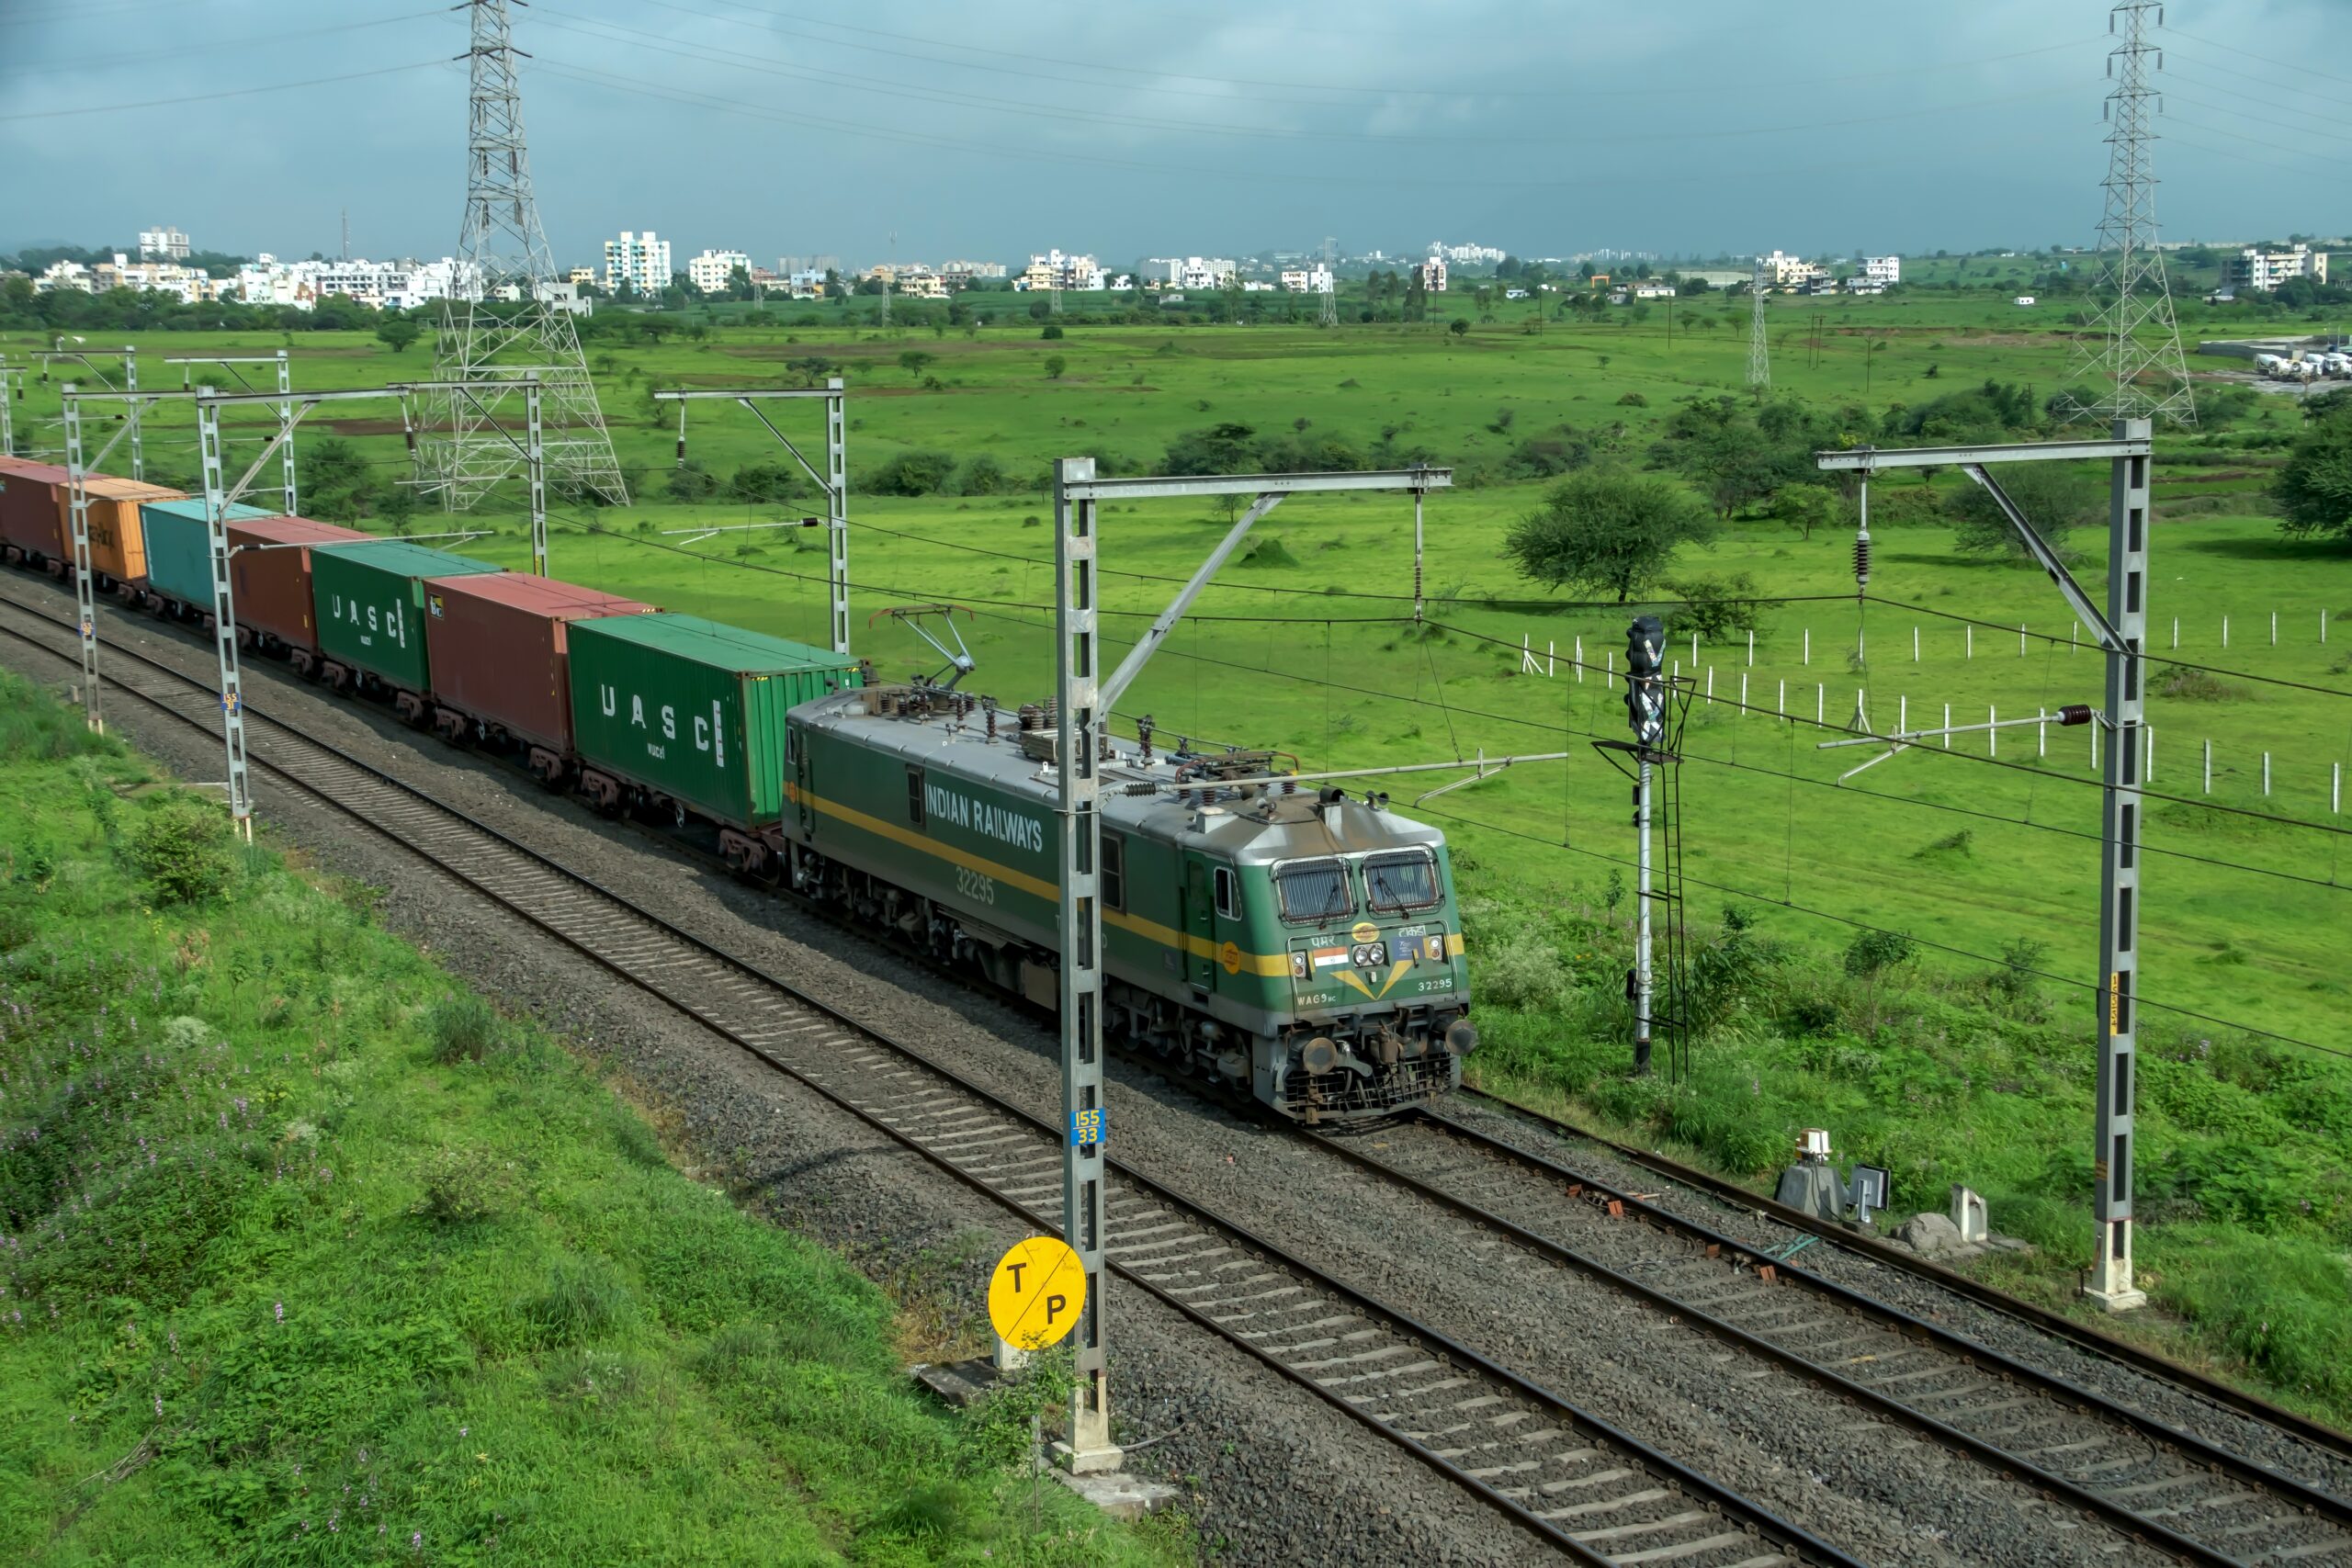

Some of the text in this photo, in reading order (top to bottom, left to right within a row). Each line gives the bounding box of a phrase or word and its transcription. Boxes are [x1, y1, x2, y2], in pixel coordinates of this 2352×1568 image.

[601, 683, 709, 751] UASC
[924, 783, 1043, 853] INDIAN RAILWAYS
[956, 865, 994, 905] 32295
[1418, 977, 1453, 992] 32295
[1075, 1109, 1100, 1127] 155
[1078, 1126, 1098, 1144] 33
[1006, 1262, 1027, 1293] T
[1046, 1293, 1067, 1325] P
